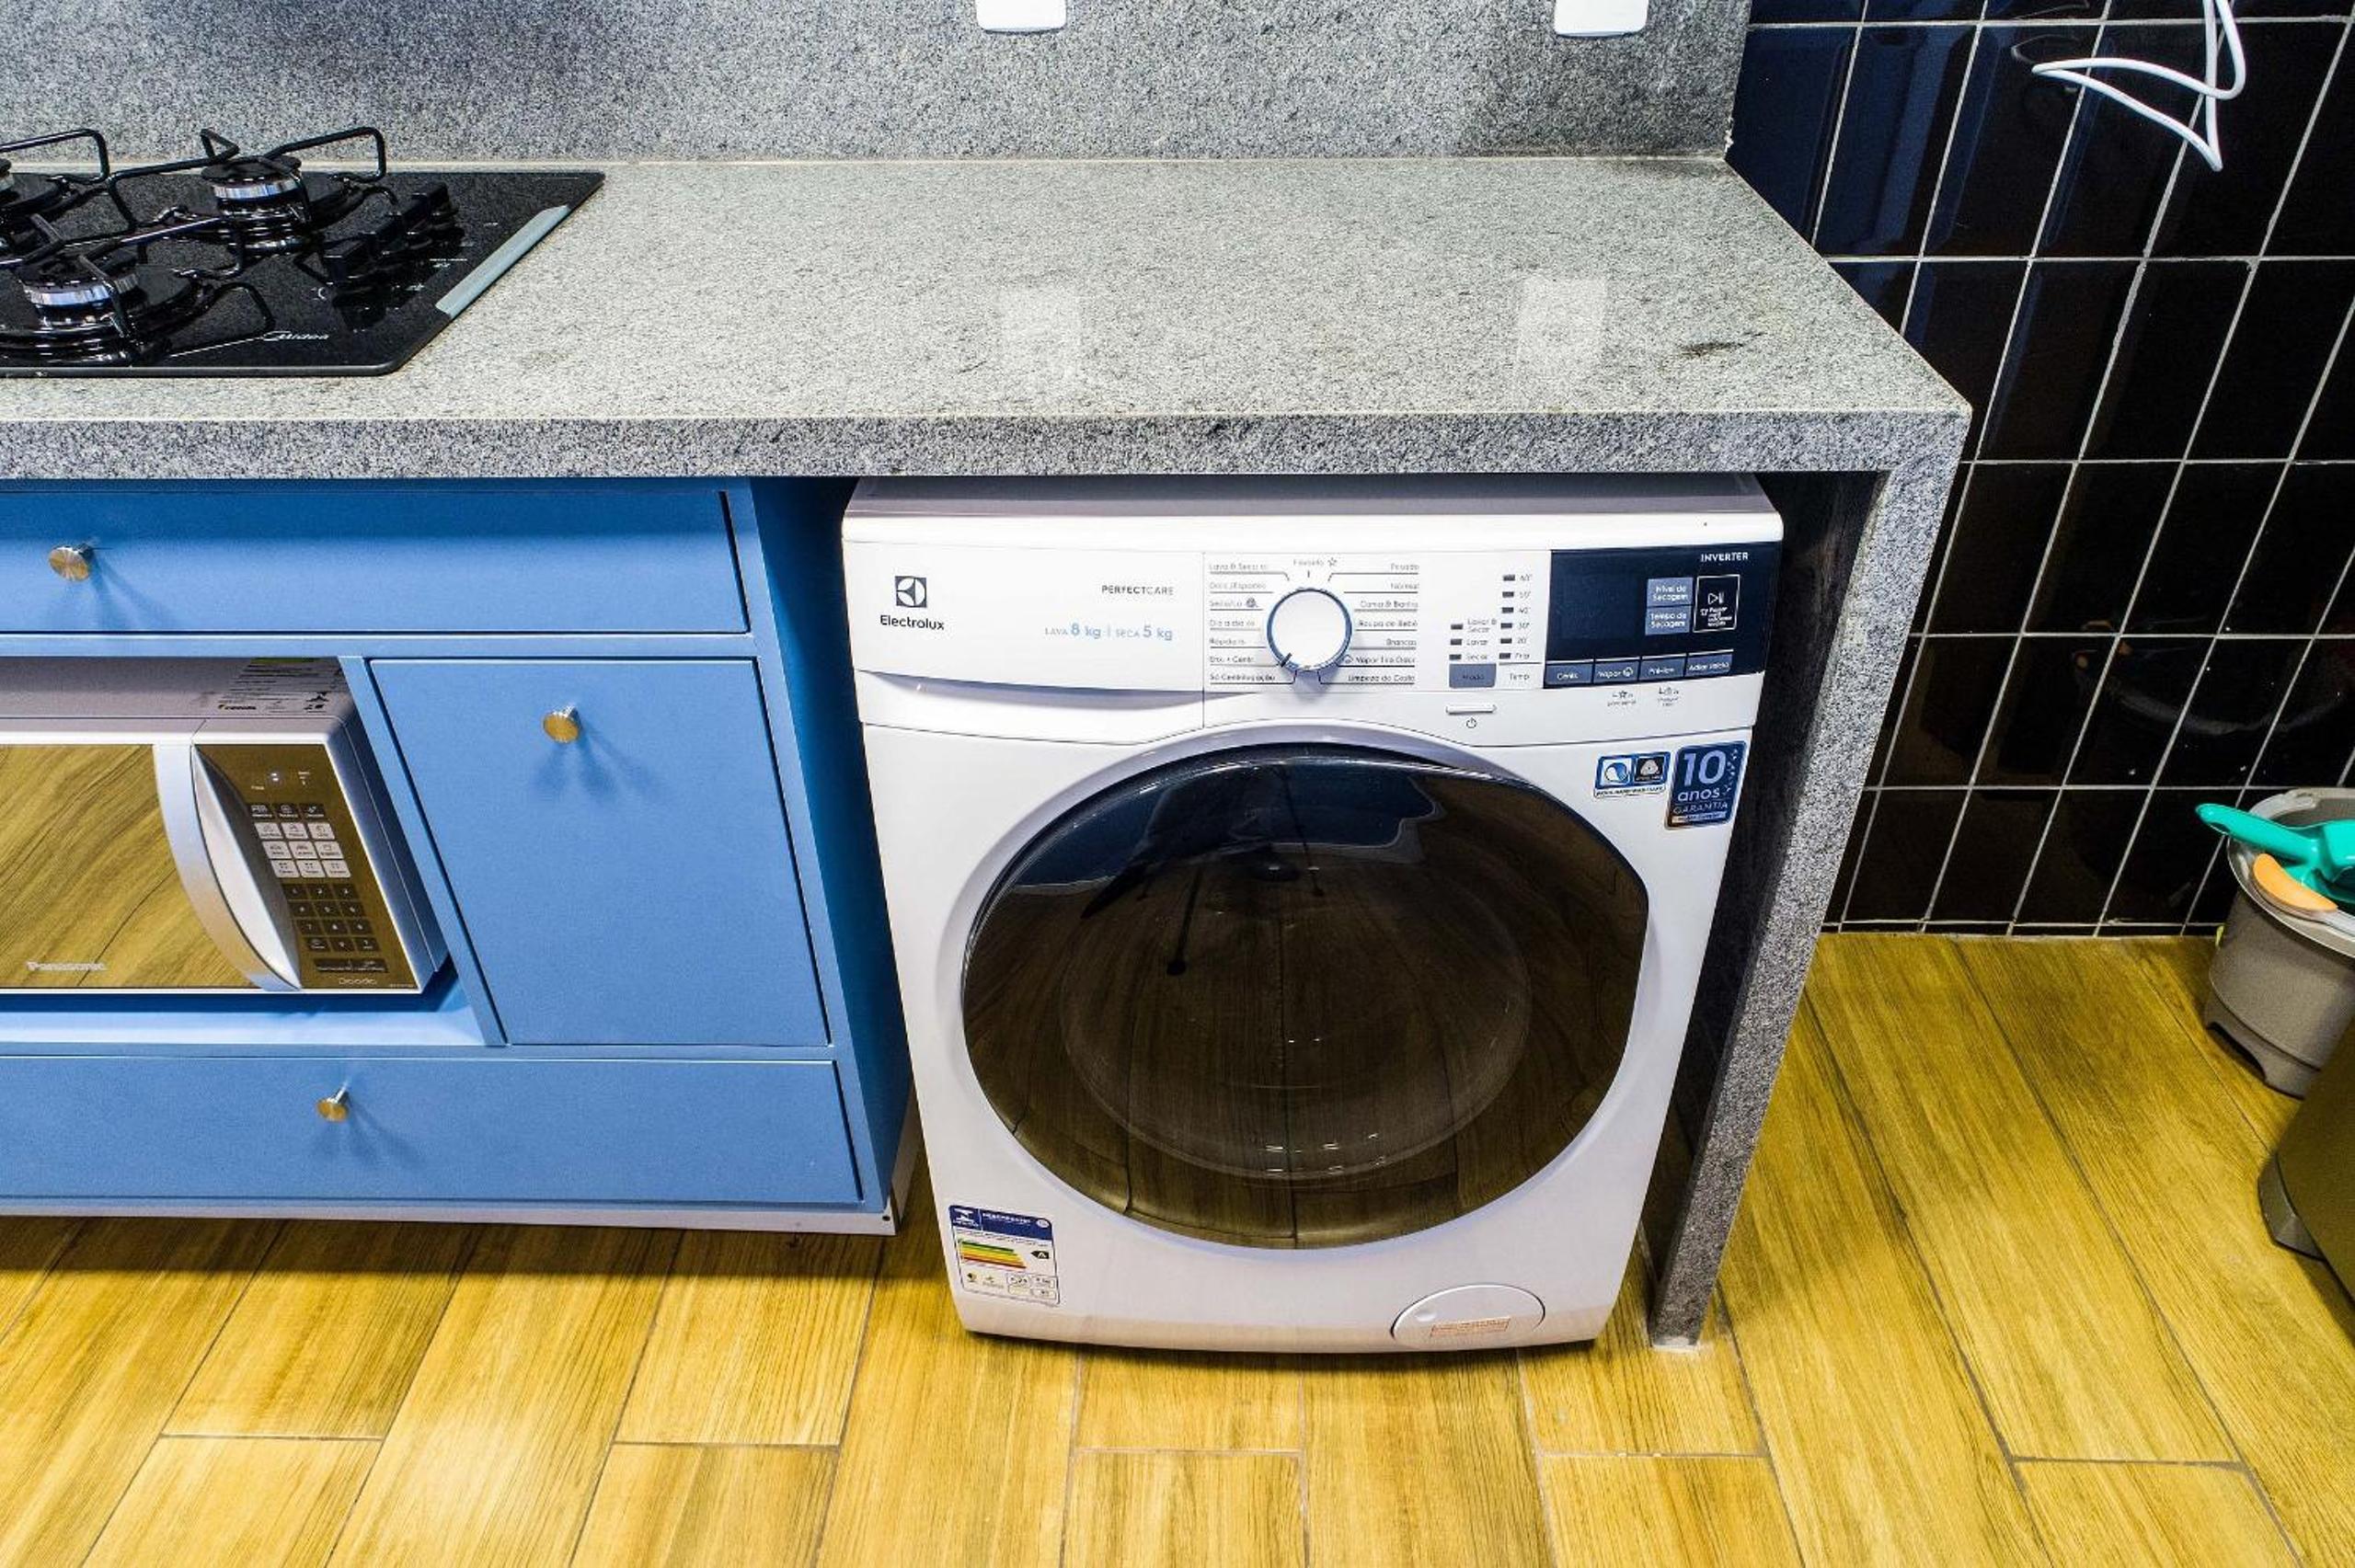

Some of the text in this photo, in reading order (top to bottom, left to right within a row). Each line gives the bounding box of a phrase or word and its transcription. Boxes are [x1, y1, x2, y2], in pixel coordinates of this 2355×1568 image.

[1701, 552, 1749, 563] INVERTER
[1101, 584, 1175, 596] PERFECTCARE
[879, 614, 945, 632] Electrolux
[1044, 622, 1102, 639] LAVA 8 kg
[1115, 624, 1174, 642] SECA 5 kg
[1683, 750, 1727, 787] 10
[1677, 787, 1720, 803] anos
[1672, 801, 1729, 815] GARANTIA
